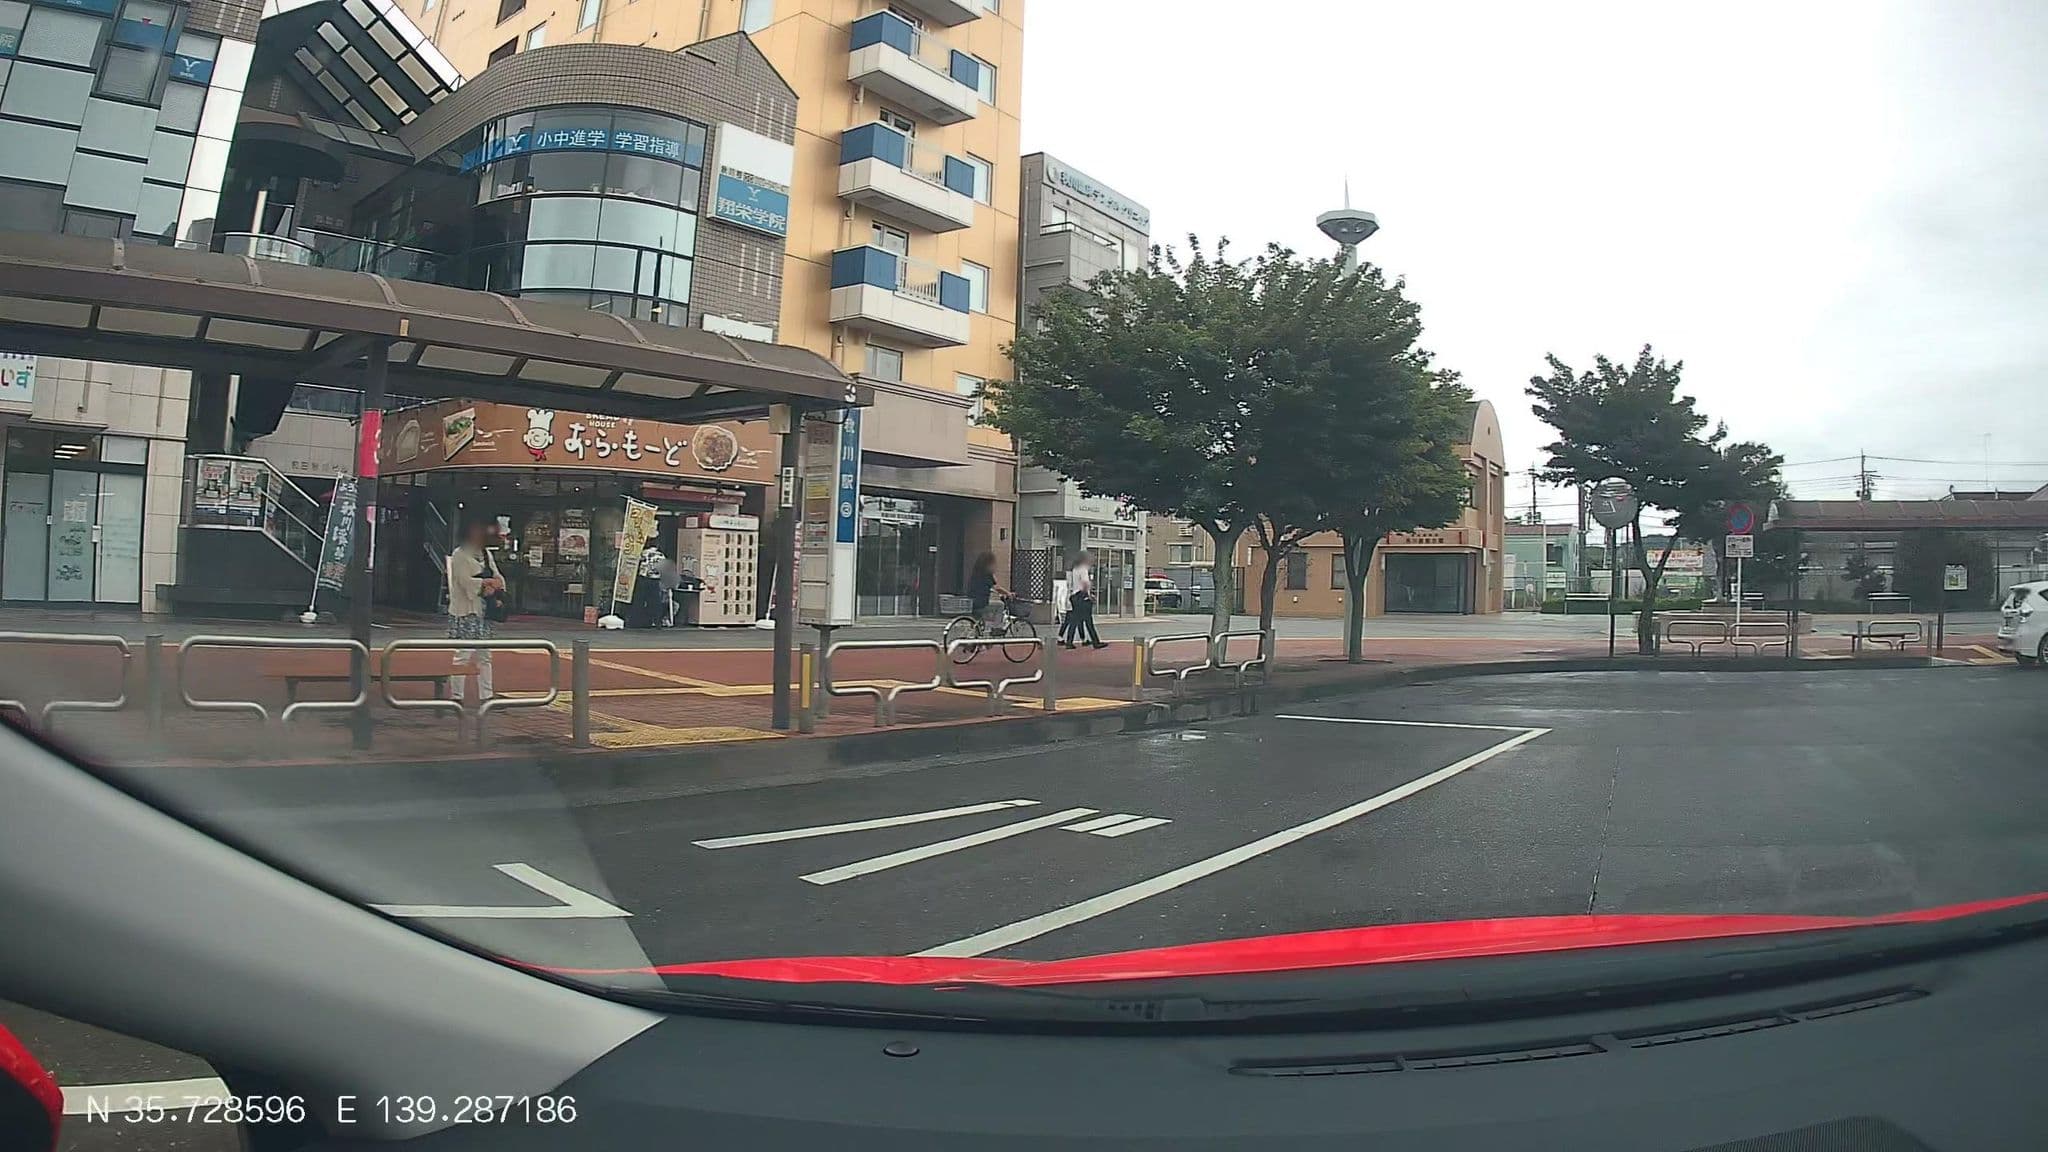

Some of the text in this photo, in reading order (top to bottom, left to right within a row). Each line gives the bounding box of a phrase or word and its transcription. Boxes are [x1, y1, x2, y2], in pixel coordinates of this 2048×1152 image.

[536, 129, 681, 158] 小中進学 学習指導
[717, 196, 787, 231] 翔栄学院
